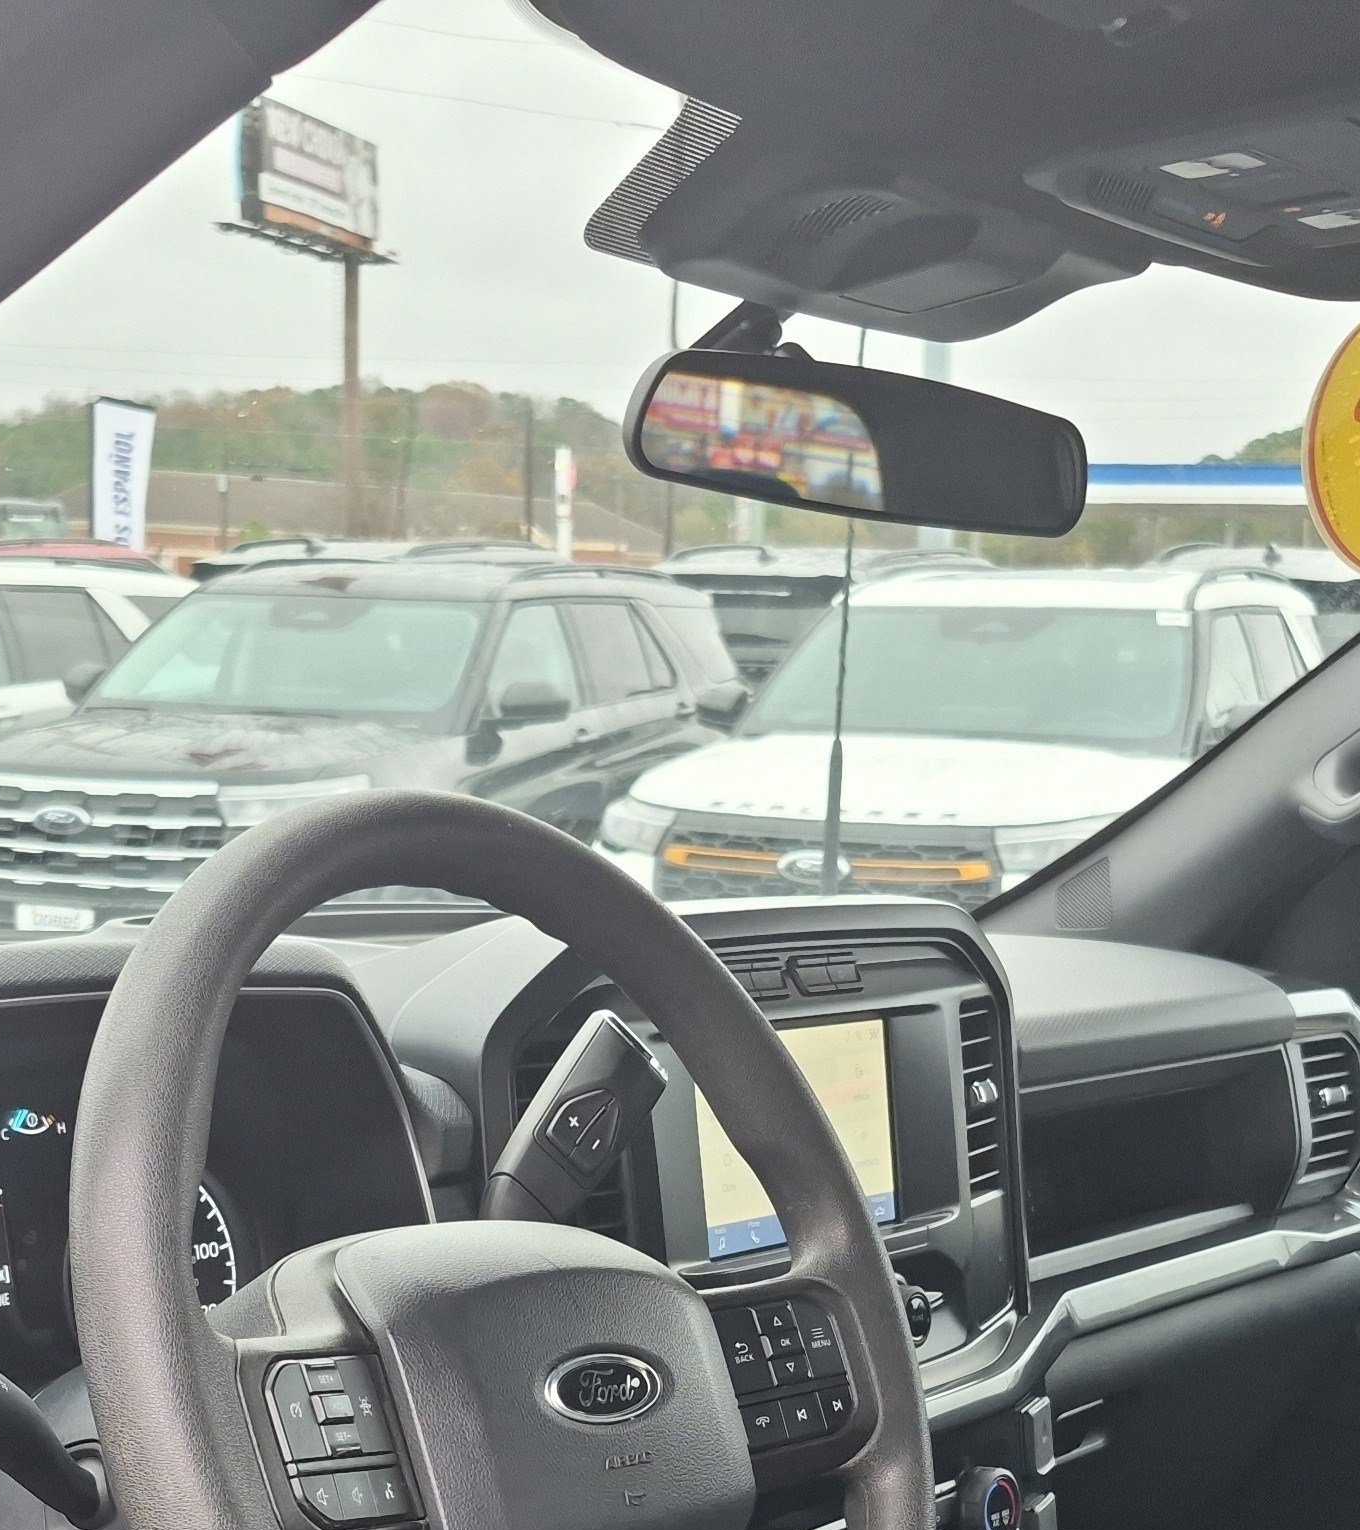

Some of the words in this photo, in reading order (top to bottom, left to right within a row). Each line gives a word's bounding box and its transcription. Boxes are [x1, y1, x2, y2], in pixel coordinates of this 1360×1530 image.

[0, 1128, 9, 1141] C
[56, 1121, 66, 1134] H
[193, 1241, 220, 1261] 100
[781, 1338, 791, 1347] OK
[811, 1339, 831, 1348] MENU
[735, 1354, 755, 1364] BACK
[579, 1368, 635, 1408] Ford
